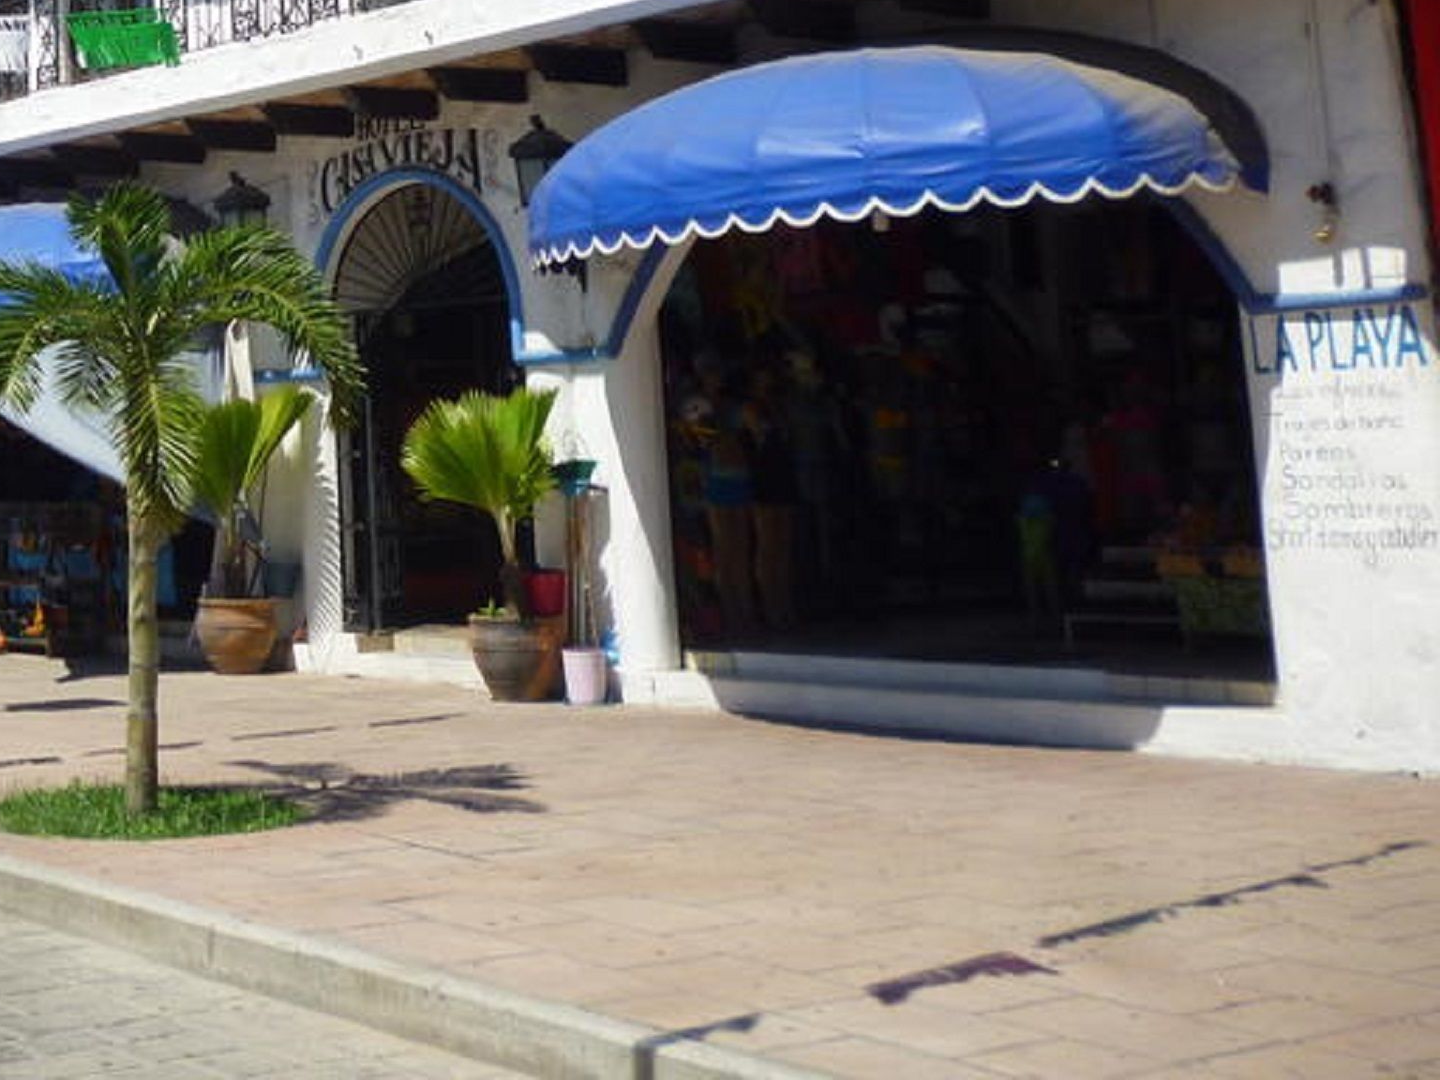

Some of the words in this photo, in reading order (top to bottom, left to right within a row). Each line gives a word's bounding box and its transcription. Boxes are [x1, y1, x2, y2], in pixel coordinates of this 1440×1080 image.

[322, 147, 378, 212] CASA
[378, 128, 482, 195] VIEJA
[1250, 313, 1298, 375] LA
[1304, 304, 1428, 372] PLAYA
